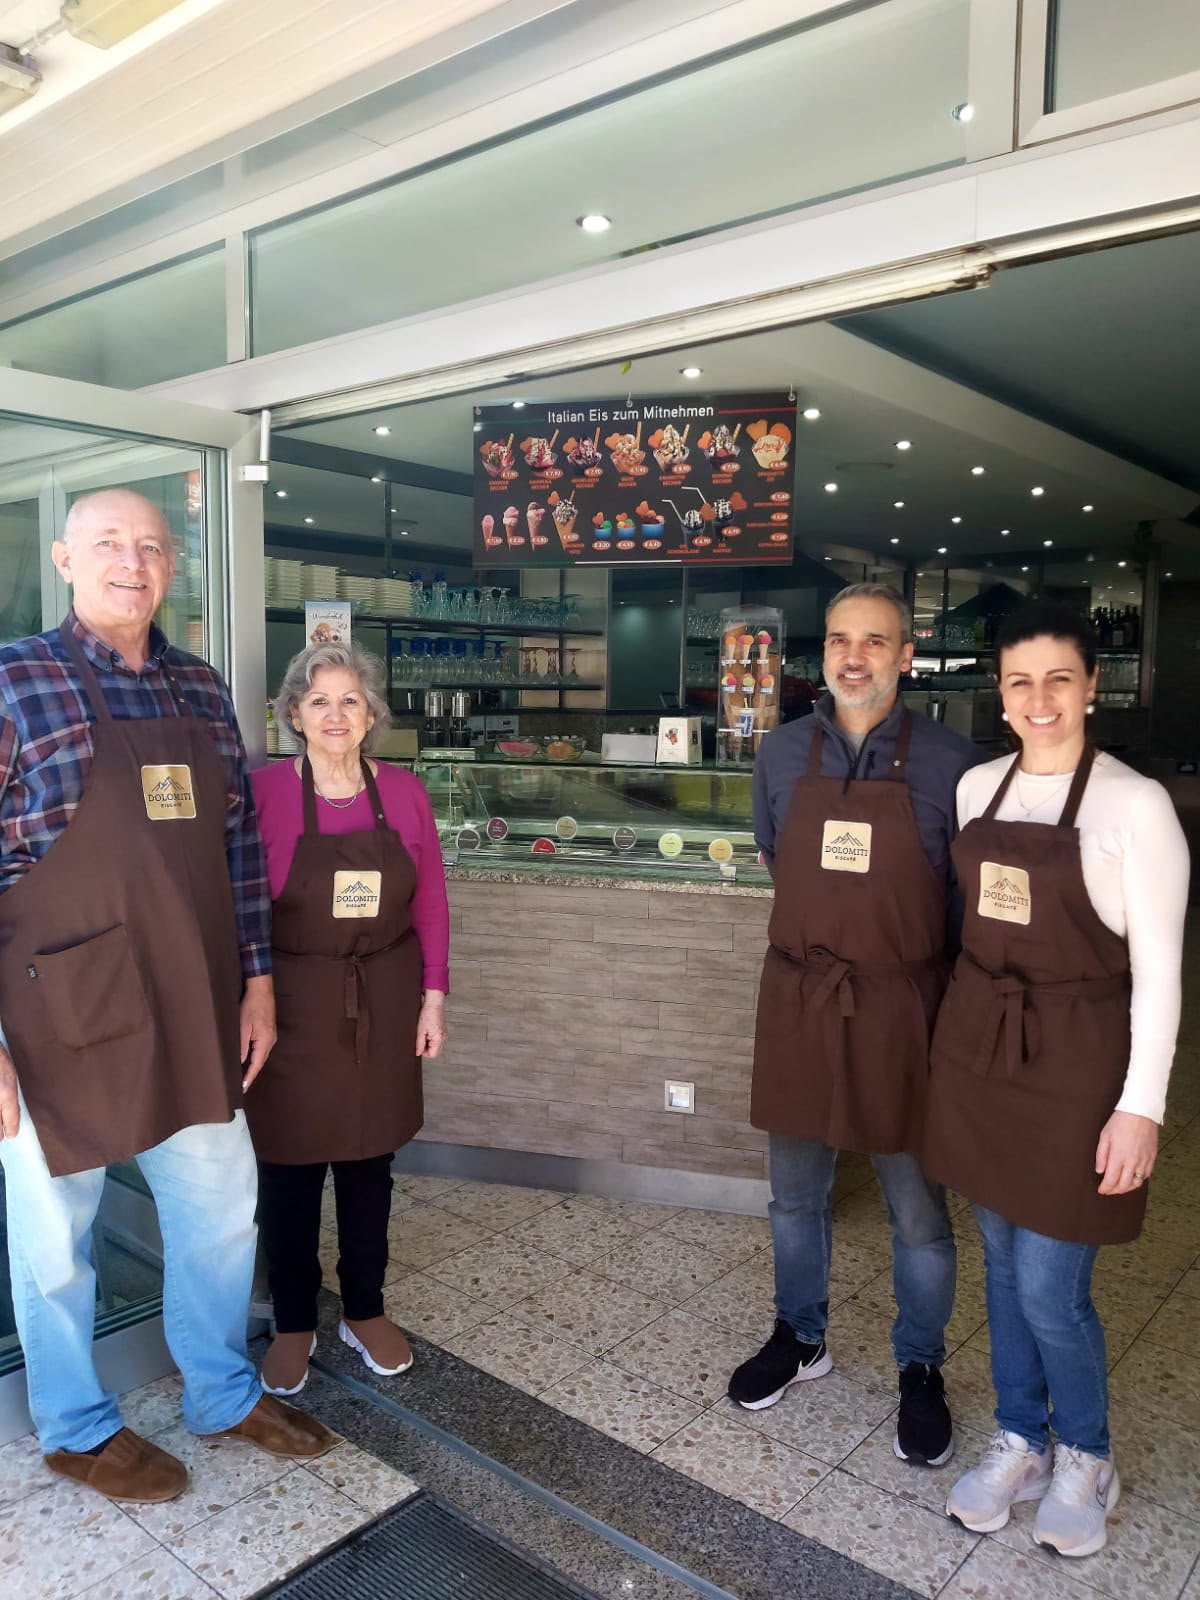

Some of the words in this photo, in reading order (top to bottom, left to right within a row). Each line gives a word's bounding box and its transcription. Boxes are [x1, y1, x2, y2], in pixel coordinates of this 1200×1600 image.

[548, 410, 585, 424] Italian
[589, 408, 609, 422] Eis
[612, 409, 639, 421] zum
[643, 405, 714, 420] Mitnehmen
[148, 792, 192, 802] DOLOMITI
[823, 845, 868, 857] DOLOMITI
[335, 895, 378, 903] DOLOMITI
[983, 889, 1029, 907] DOLOMITI
